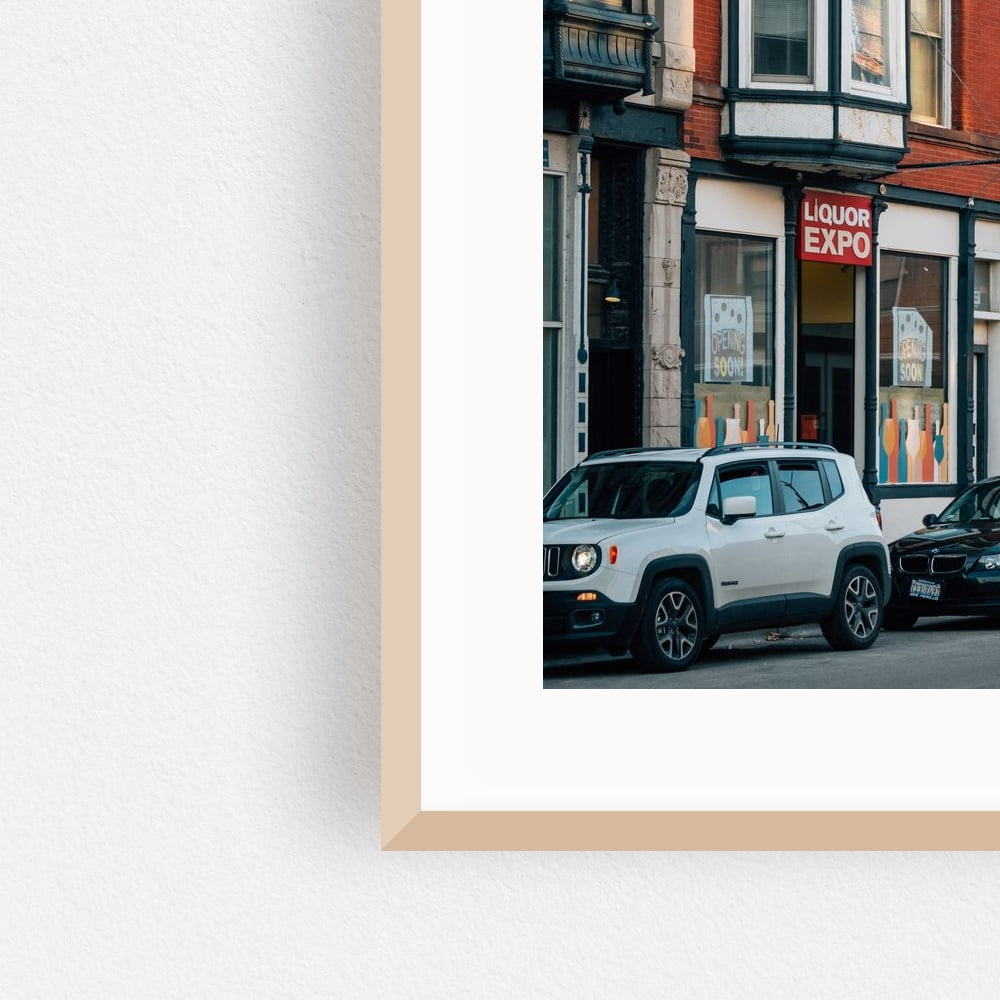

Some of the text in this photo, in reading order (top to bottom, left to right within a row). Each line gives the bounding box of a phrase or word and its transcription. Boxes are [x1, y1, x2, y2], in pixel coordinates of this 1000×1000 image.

[804, 198, 870, 228] LIQUOR
[804, 226, 871, 259] EXPO
[711, 329, 746, 355] OPENING
[714, 355, 744, 377] SOON!
